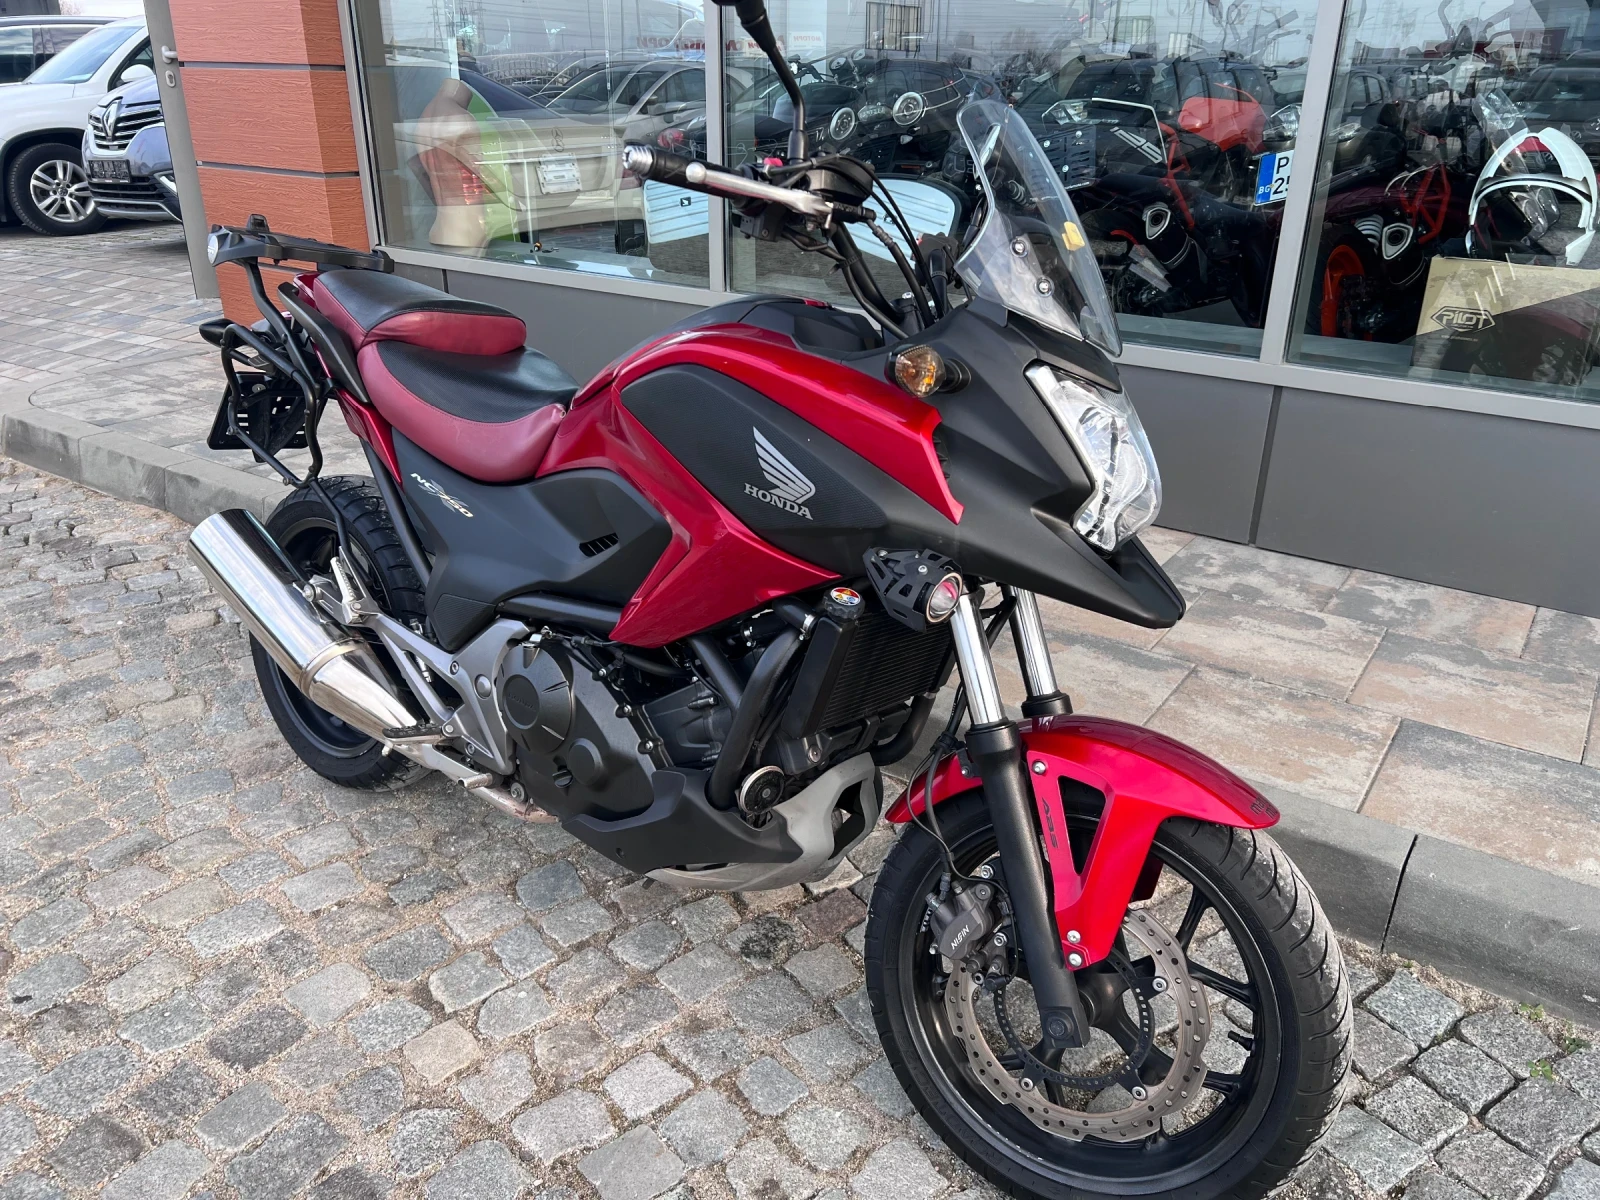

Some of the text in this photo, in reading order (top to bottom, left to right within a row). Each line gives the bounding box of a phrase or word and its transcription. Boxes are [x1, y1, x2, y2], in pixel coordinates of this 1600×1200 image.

[1276, 156, 1290, 175] P
[1258, 184, 1271, 195] BG
[743, 482, 814, 521] HONDA
[1041, 797, 1059, 849] ABS
